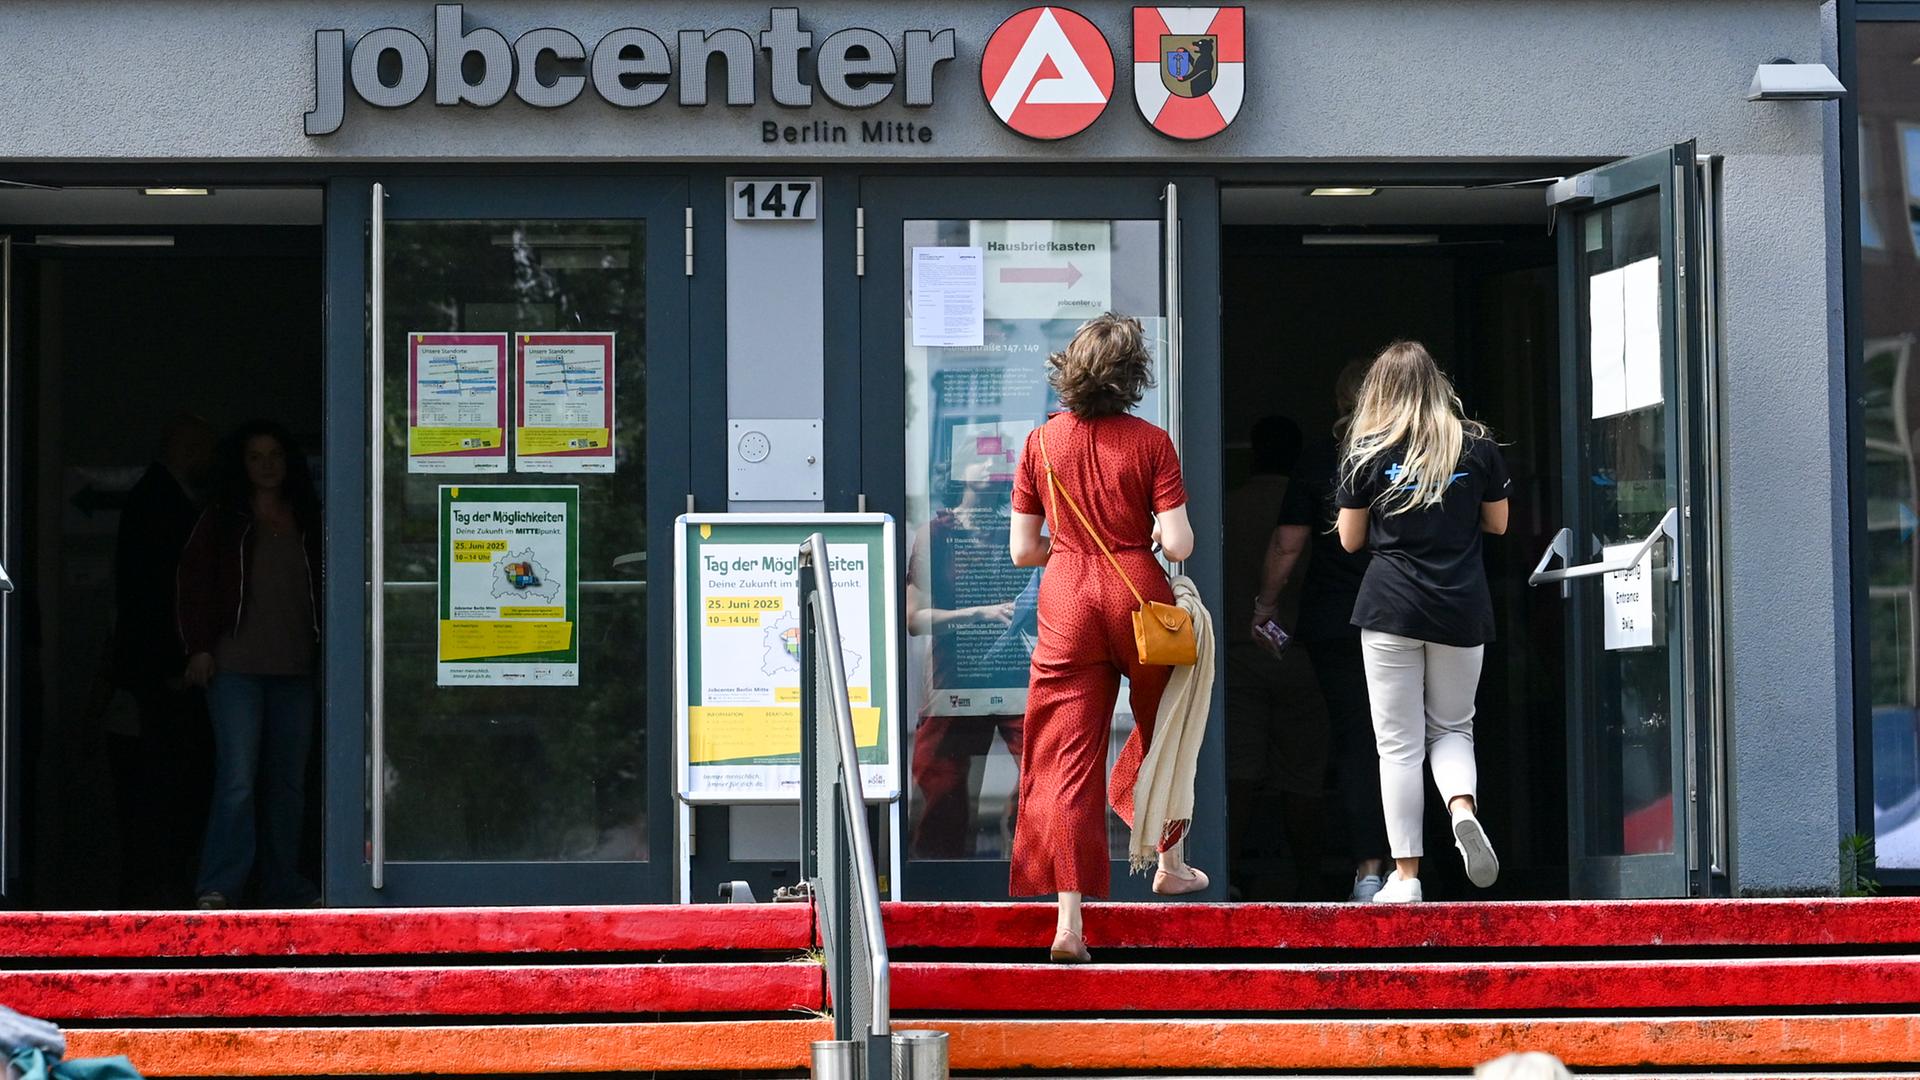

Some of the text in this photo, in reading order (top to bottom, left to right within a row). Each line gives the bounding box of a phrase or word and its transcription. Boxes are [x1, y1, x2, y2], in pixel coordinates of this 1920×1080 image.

[304, 3, 956, 137] jobcenter
[762, 120, 933, 143] Berlin Mitte
[738, 183, 812, 218] 147
[987, 241, 1096, 251] Hausbriefkasten
[453, 510, 564, 525] Tag der Möglichkeiten
[455, 542, 505, 550] 25. Juni 2025
[704, 555, 728, 575] Tag
[732, 556, 759, 571] der
[709, 579, 736, 588] Deine
[739, 579, 777, 588] Zukunft
[780, 579, 792, 588] im
[708, 599, 780, 609] 25. Juni 2025
[1616, 592, 1640, 605] Entrance
